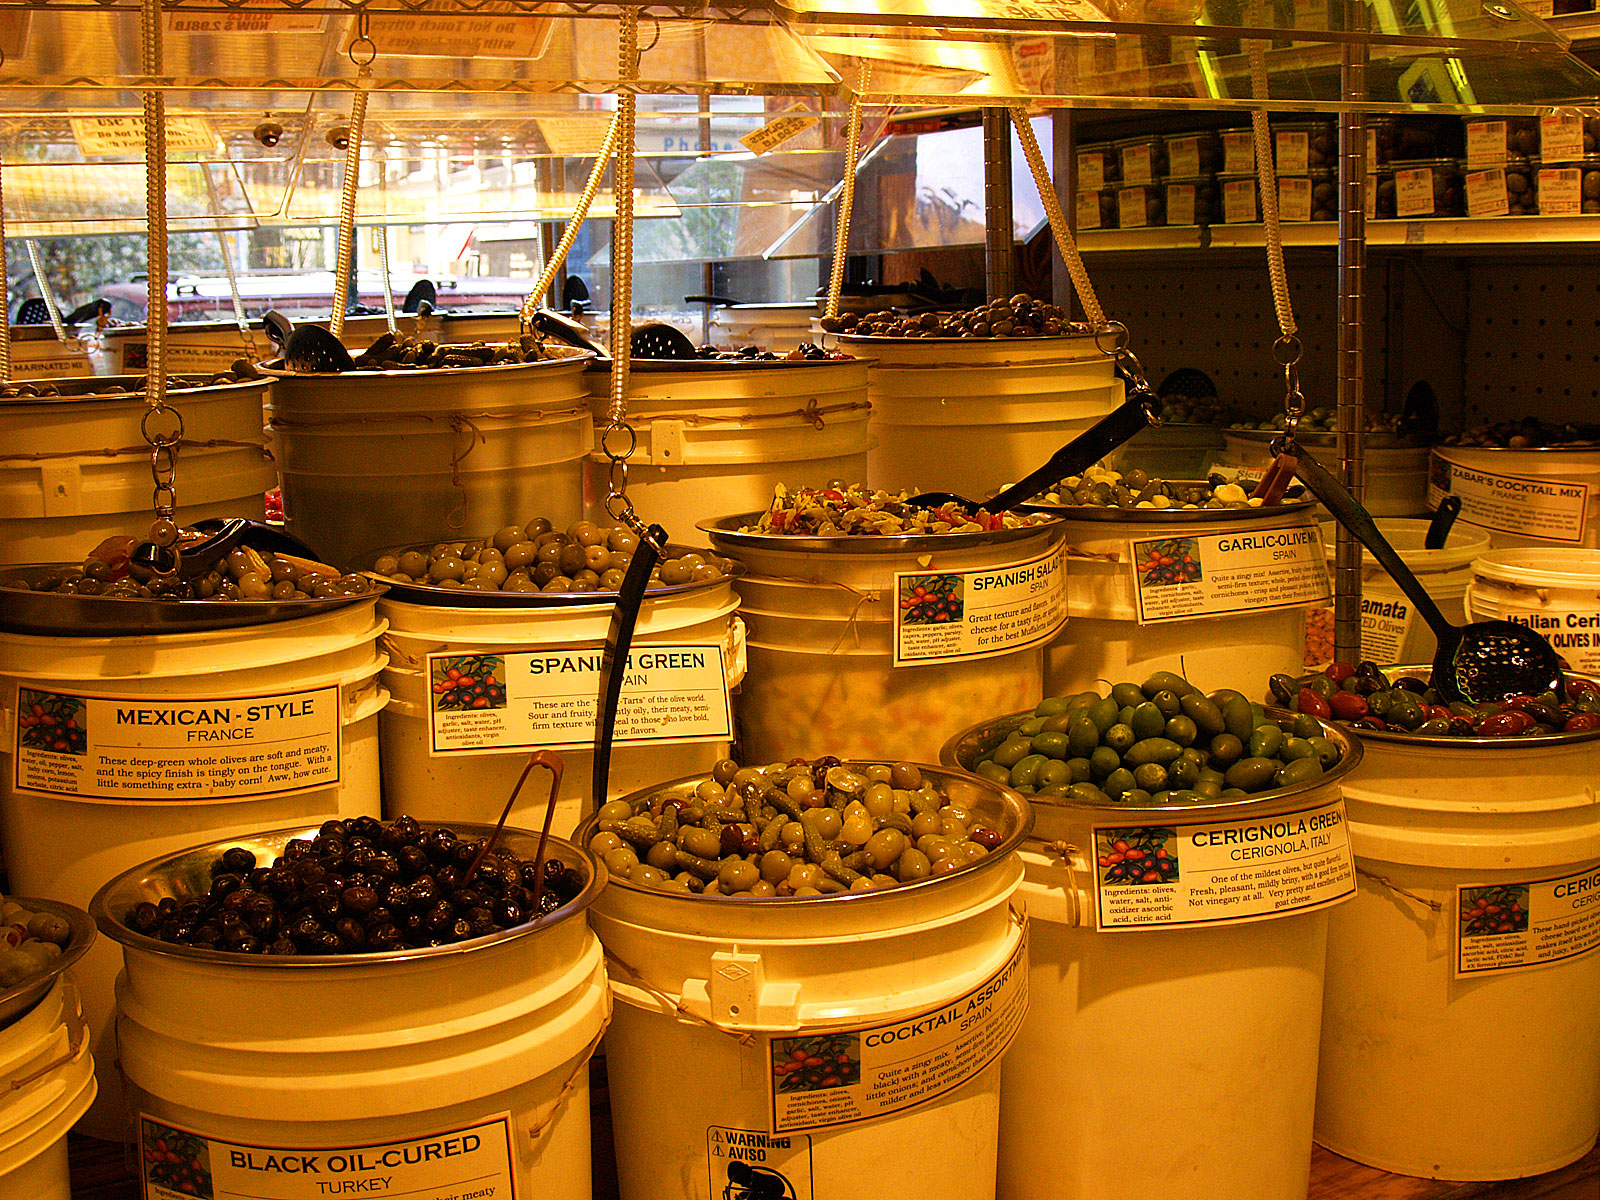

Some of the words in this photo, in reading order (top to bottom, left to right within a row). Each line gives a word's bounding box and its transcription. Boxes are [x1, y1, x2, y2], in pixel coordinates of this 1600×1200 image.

[1453, 468, 1494, 486] ZABAR'S
[1495, 480, 1557, 496] COCKTAIL
[1559, 488, 1582, 498] MIX
[1492, 490, 1528, 501] FRANCE
[1218, 532, 1307, 552] GARLIC-OLIVE
[1273, 550, 1296, 560] SPAIN
[973, 568, 1035, 590] SPANISH
[1030, 579, 1049, 593] SPAIN
[1212, 575, 1229, 583] Quite
[1236, 573, 1252, 581] zingy
[1217, 581, 1247, 590] semi-firm
[1211, 590, 1249, 599] cornichones
[969, 613, 992, 624] Great
[994, 609, 1019, 620] texture
[1020, 604, 1032, 615] and
[1361, 600, 1407, 620] amata
[970, 625, 997, 635] cheese
[1000, 622, 1009, 631] for
[1017, 618, 1032, 626] tasty
[1378, 620, 1404, 634] Olives
[978, 636, 989, 645] for
[991, 635, 1004, 644] the
[1006, 631, 1019, 640] best
[1554, 633, 1590, 648] OLIVES
[530, 655, 632, 674] SPANIH
[639, 653, 704, 669] GREEN
[117, 708, 230, 726] MEXICAN
[247, 699, 314, 721] STYLE
[533, 701, 558, 709] These
[528, 712, 548, 720] Sour
[551, 711, 568, 719] and
[532, 722, 550, 730] firm
[552, 721, 583, 729] texture
[641, 716, 660, 724] those
[187, 727, 254, 742] FRANCE
[631, 727, 657, 735] flavors.
[99, 756, 127, 765] These
[130, 757, 185, 768] deep-green
[188, 757, 217, 766] whole
[220, 756, 247, 764] olives
[267, 751, 283, 760] soft
[285, 748, 301, 758] and
[304, 744, 329, 755] meaty,
[96, 768, 114, 776] and
[117, 768, 134, 777] the
[137, 770, 162, 779] spicy
[165, 769, 193, 778] finish
[196, 768, 205, 777] is
[208, 767, 235, 777] tingly
[253, 764, 268, 773] the
[270, 761, 302, 771] tongue.
[307, 756, 325, 765] With
[97, 779, 119, 787] little
[122, 780, 174, 791] something
[176, 781, 202, 789] extra
[212, 779, 236, 788] baby
[239, 776, 262, 785] corn!
[268, 774, 291, 783] Aww,
[293, 770, 310, 779] how
[312, 766, 331, 776] cute.
[1192, 819, 1307, 847] CERIGNOLA
[1310, 809, 1342, 832] GREEN
[1231, 840, 1309, 860] CERIGNOLA,
[1311, 833, 1332, 848] ITALY
[1255, 869, 1281, 878] mildest
[1190, 887, 1217, 896] Fresh,
[1220, 883, 1256, 895] pleasant,
[1258, 879, 1279, 888] mildly
[1301, 872, 1313, 880] with
[1554, 873, 1600, 898] CERIG
[1105, 889, 1150, 897] Ingredients:
[1206, 896, 1240, 905] vinegary
[1286, 886, 1304, 895] pretty
[1142, 904, 1173, 912] ascorbic
[1275, 900, 1289, 908] goat
[1533, 926, 1552, 934] These
[1554, 922, 1570, 930] hand
[1541, 933, 1562, 941] cheese
[1564, 928, 1580, 937] board
[960, 1003, 992, 1031] SPAIN
[866, 1008, 962, 1047] COCKTAIL
[878, 1070, 902, 1080] Quite
[912, 1059, 932, 1070] zingy
[866, 1091, 886, 1100] little
[921, 1074, 936, 1085] and
[873, 1078, 899, 1089] black)
[902, 1072, 919, 1081] with
[880, 1093, 907, 1107] milder
[909, 1087, 925, 1098] and
[927, 1082, 941, 1092] less
[230, 1150, 321, 1174] BLACK
[327, 1134, 481, 1173] OIL-CURED
[728, 1146, 766, 1162] AVISO
[316, 1176, 393, 1194] TURKEY
[462, 1186, 496, 1200] meaty
